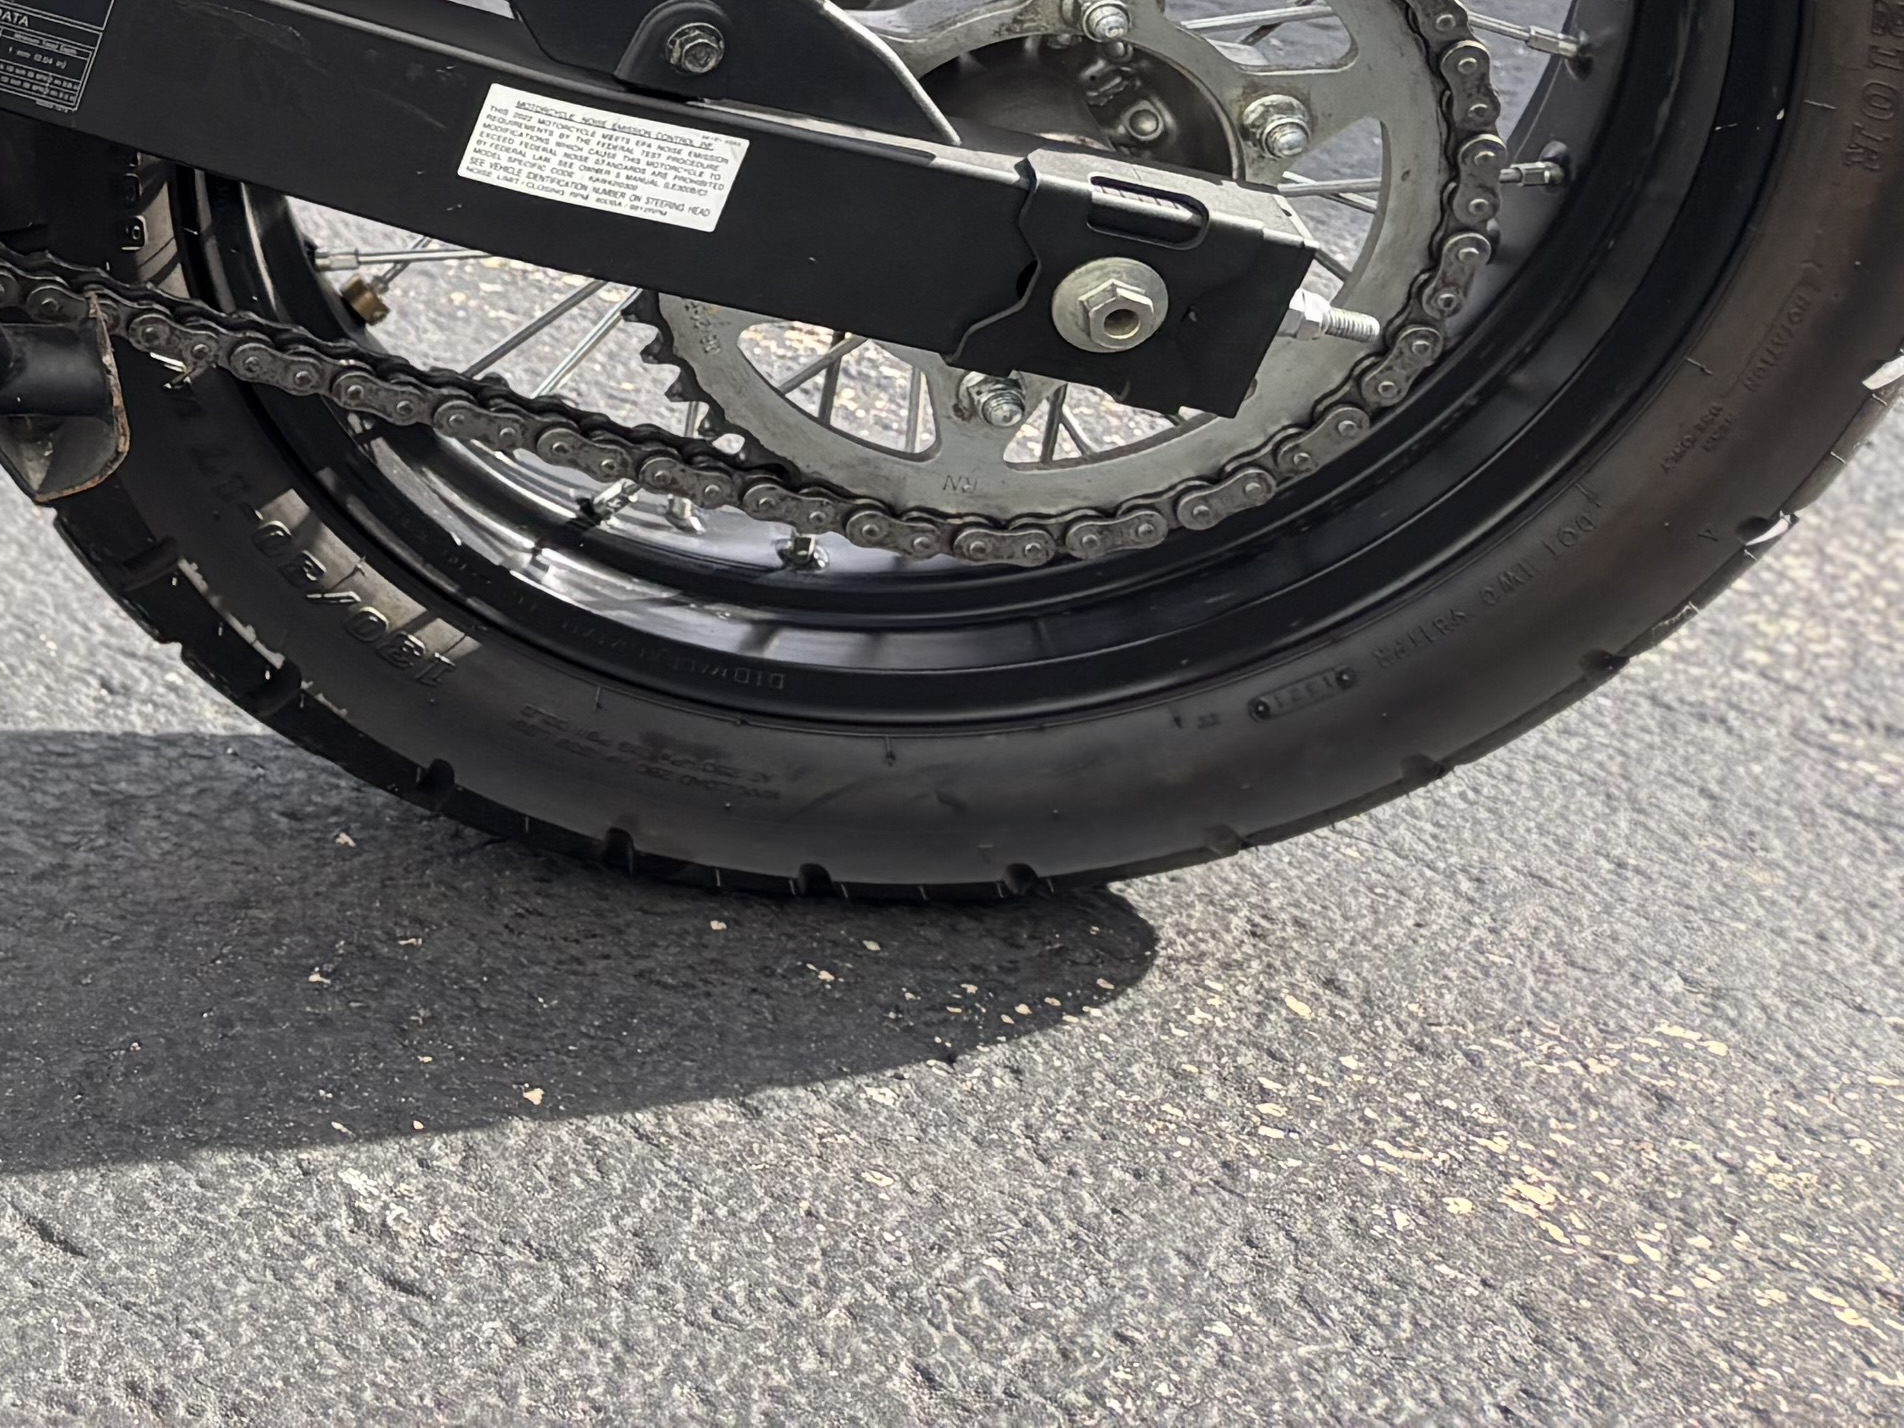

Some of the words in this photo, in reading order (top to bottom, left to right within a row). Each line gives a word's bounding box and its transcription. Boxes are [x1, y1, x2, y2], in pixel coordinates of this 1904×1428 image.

[472, 147, 503, 160] MODEL
[505, 155, 547, 171] SPECIFIC
[478, 130, 515, 145] EXCEED
[518, 140, 559, 156] FEDERAL
[562, 151, 589, 163] NOISE
[593, 157, 647, 175] STANDARDS
[672, 173, 725, 191] PROHIBITED
[481, 122, 551, 145] MODIFICATIONS
[587, 147, 617, 160] CAUSE
[645, 159, 704, 178] MOTORCYCLE
[484, 114, 555, 136] REQUIREMENTS
[595, 140, 635, 154] FEDERAL
[640, 149, 661, 160] TEST
[488, 142, 528, 157] FEDERAL
[489, 105, 509, 115] THIS
[536, 118, 596, 137] MOTORCYCLE
[635, 139, 652, 148] EPA
[656, 144, 682, 155] NOISE
[687, 150, 729, 165] EMISSION
[468, 156, 486, 167] SEE
[487, 161, 523, 177] VEHICLE
[524, 170, 589, 192] IDENTIFICATION
[591, 185, 626, 200] NUMBER
[644, 195, 686, 213] STEERING
[686, 204, 711, 218] HEAD
